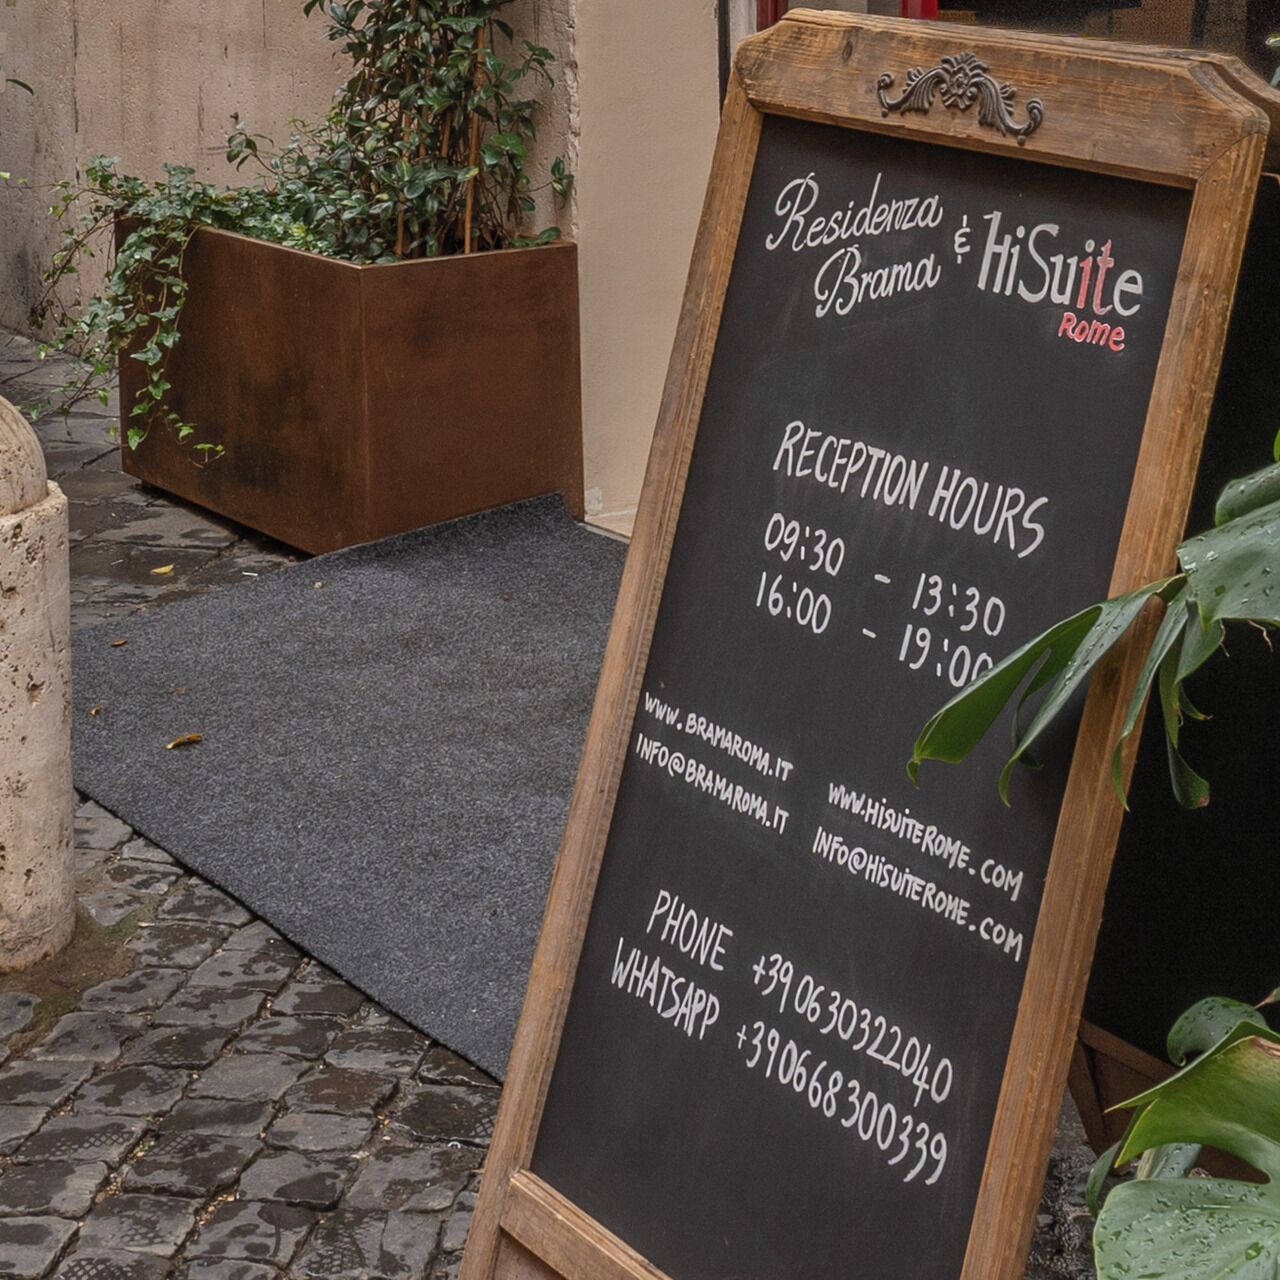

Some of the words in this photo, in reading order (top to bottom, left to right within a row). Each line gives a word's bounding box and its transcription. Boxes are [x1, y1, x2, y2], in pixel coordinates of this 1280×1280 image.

[765, 172, 943, 251] Residenza
[814, 244, 941, 318] Brama
[1058, 311, 1125, 352] Rome
[773, 420, 928, 510] RECEPTION
[928, 465, 1049, 558] HOURS
[756, 571, 832, 634] 16:00
[764, 513, 845, 576] 09:30
[912, 572, 1005, 636] 13:30
[646, 889, 733, 971] PHONE
[611, 937, 720, 1040] WHATSAPP
